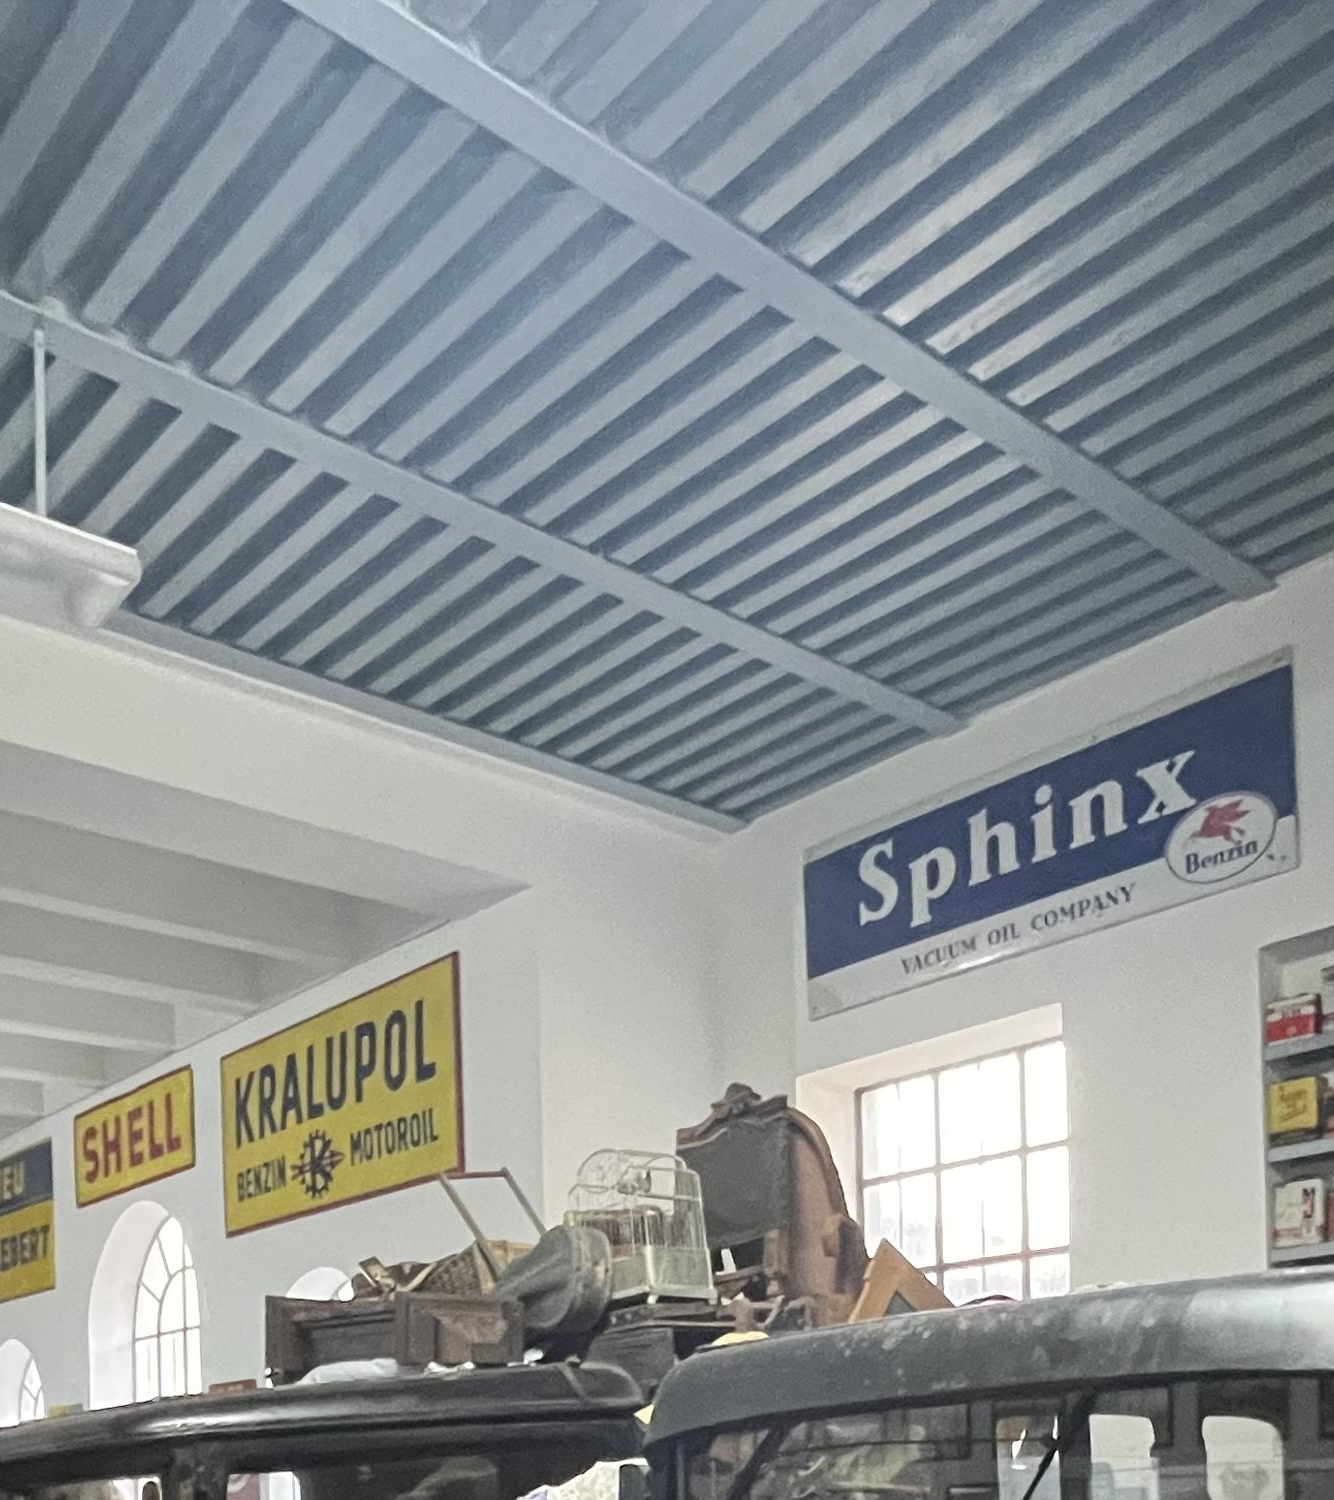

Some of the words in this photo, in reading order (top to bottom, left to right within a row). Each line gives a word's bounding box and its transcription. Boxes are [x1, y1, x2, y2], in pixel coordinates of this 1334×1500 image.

[858, 750, 1197, 927] Sphinx
[1185, 840, 1259, 875] Benzin
[901, 935, 977, 976] VACUUM
[987, 921, 1021, 947] OIL
[1030, 883, 1137, 933] COMPANY
[234, 999, 437, 1149] KRALUPOL
[82, 1092, 183, 1184] SHELL
[237, 1158, 287, 1203] BENZIN
[350, 1109, 439, 1167] MOTOROIL
